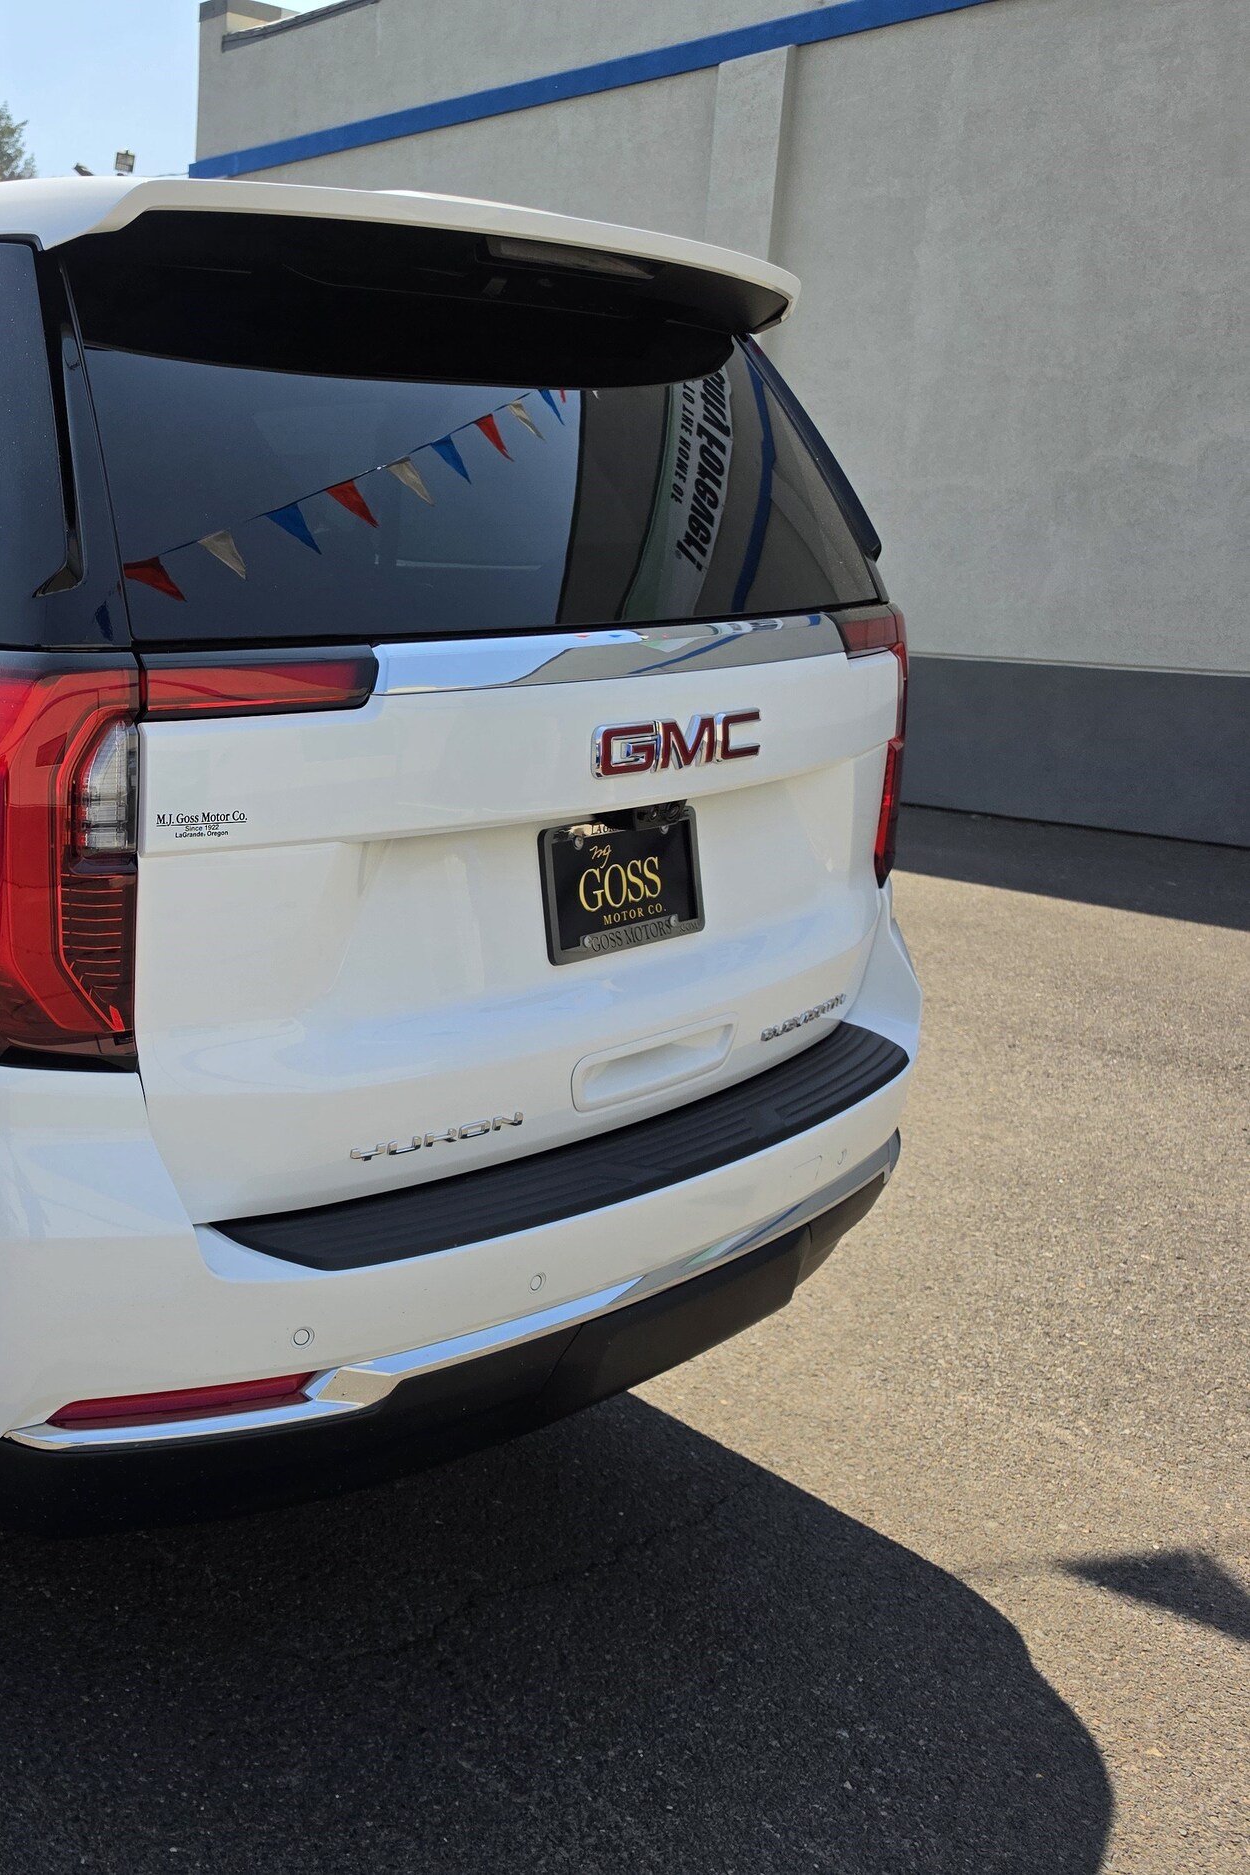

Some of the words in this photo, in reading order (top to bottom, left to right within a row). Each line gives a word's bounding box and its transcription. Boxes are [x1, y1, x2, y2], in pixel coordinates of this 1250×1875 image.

[591, 707, 761, 780] GMC
[156, 814, 174, 827] M.J.
[176, 813, 199, 824] Goss
[201, 812, 230, 823] Motor
[232, 810, 248, 821] Co.
[207, 830, 228, 838] Oregon
[578, 856, 662, 913] GOSS
[603, 907, 644, 926] MOTOR
[647, 902, 667, 916] CO.
[591, 931, 624, 953] GOSS
[623, 919, 672, 945] MOTORS
[350, 1111, 524, 1161] YUKON
